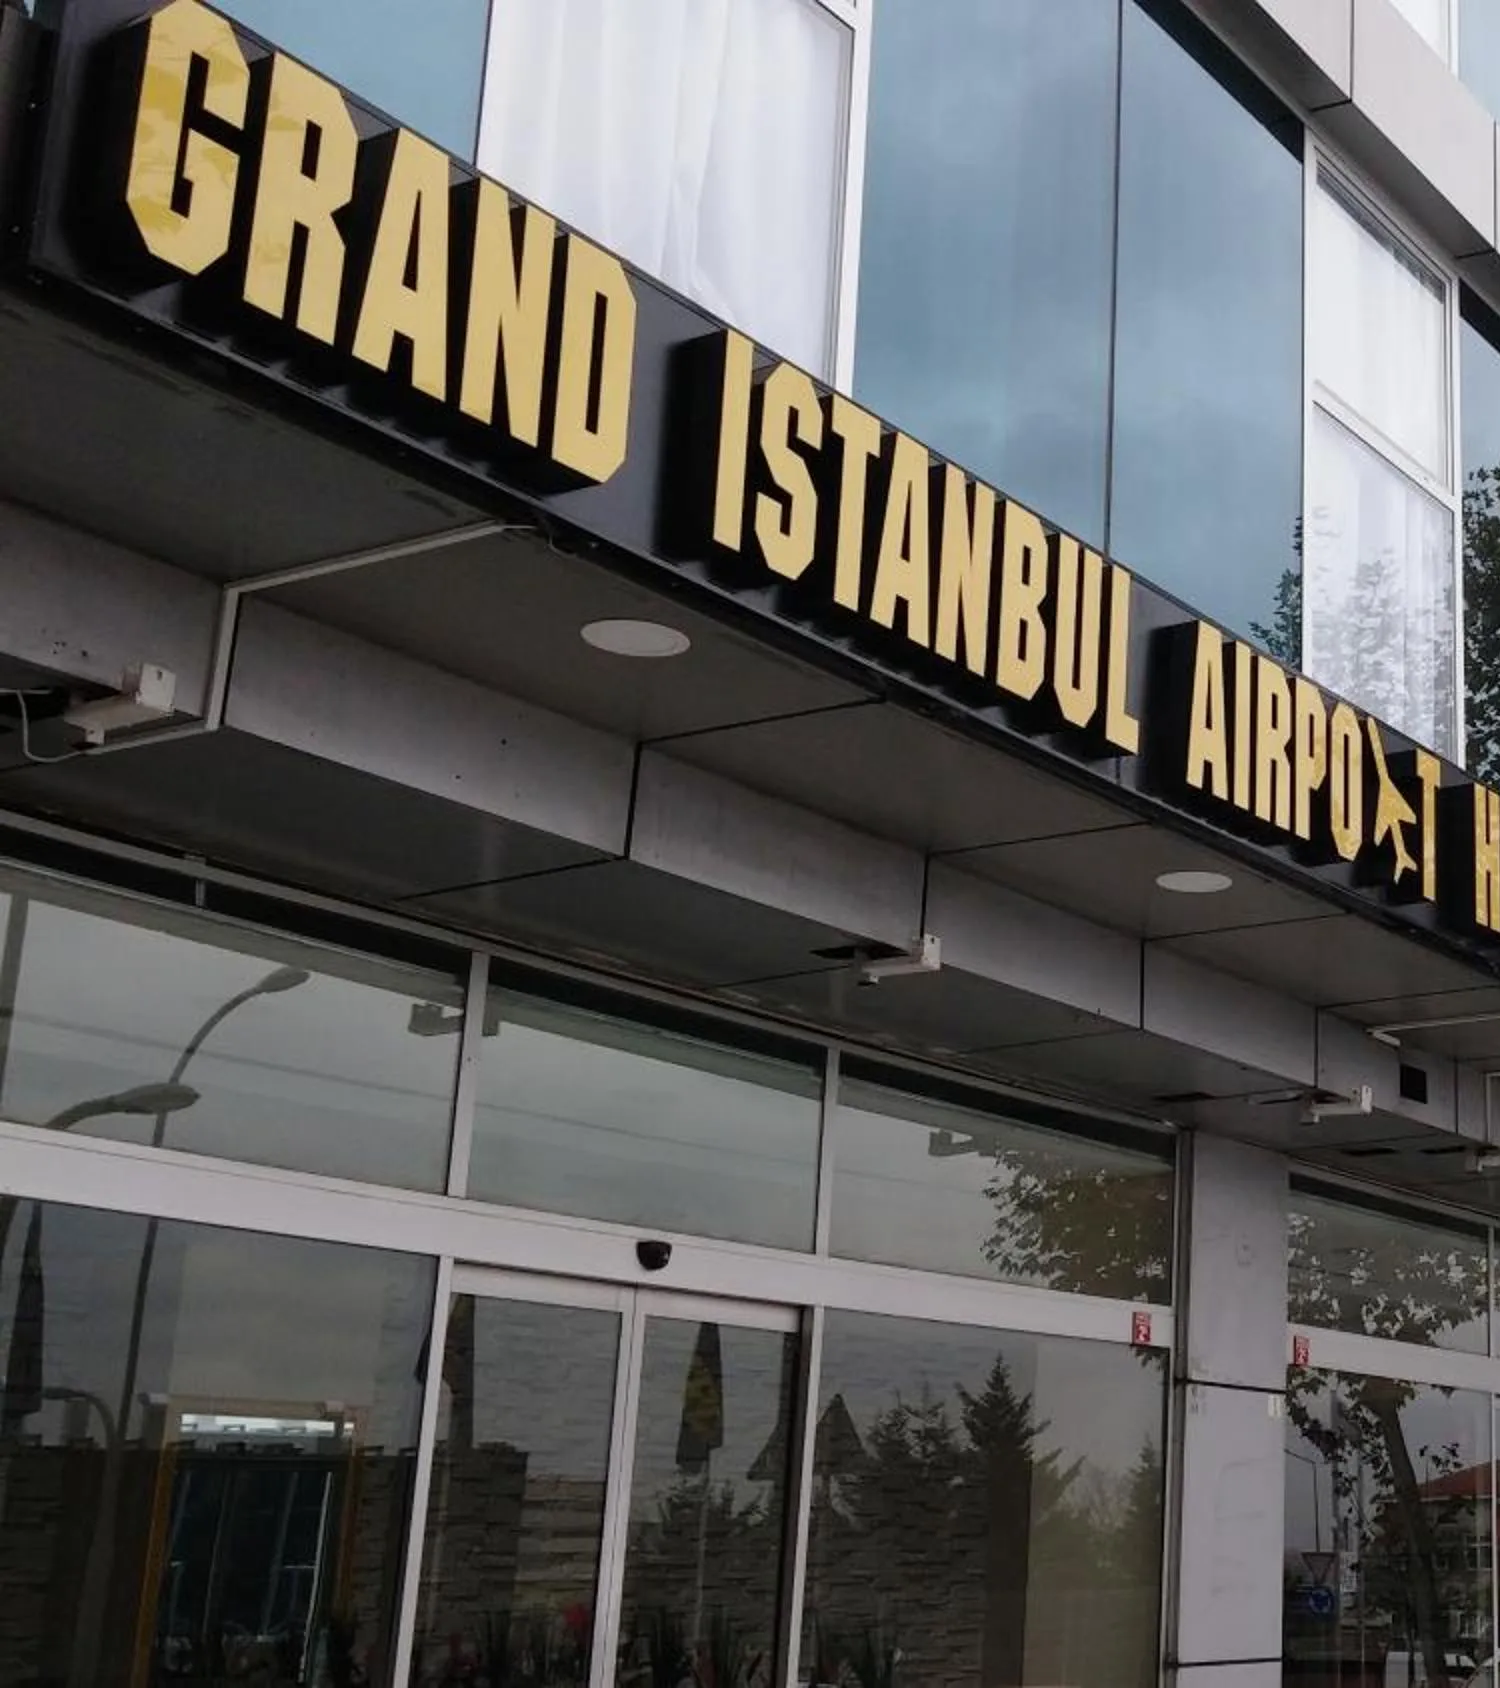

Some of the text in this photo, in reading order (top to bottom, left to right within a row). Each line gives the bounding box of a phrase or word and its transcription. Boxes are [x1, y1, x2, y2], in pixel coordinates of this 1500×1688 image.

[126, 0, 637, 484] GRAND
[713, 328, 1139, 755] ISTANBUL
[1186, 620, 1442, 903] AIRPOT
